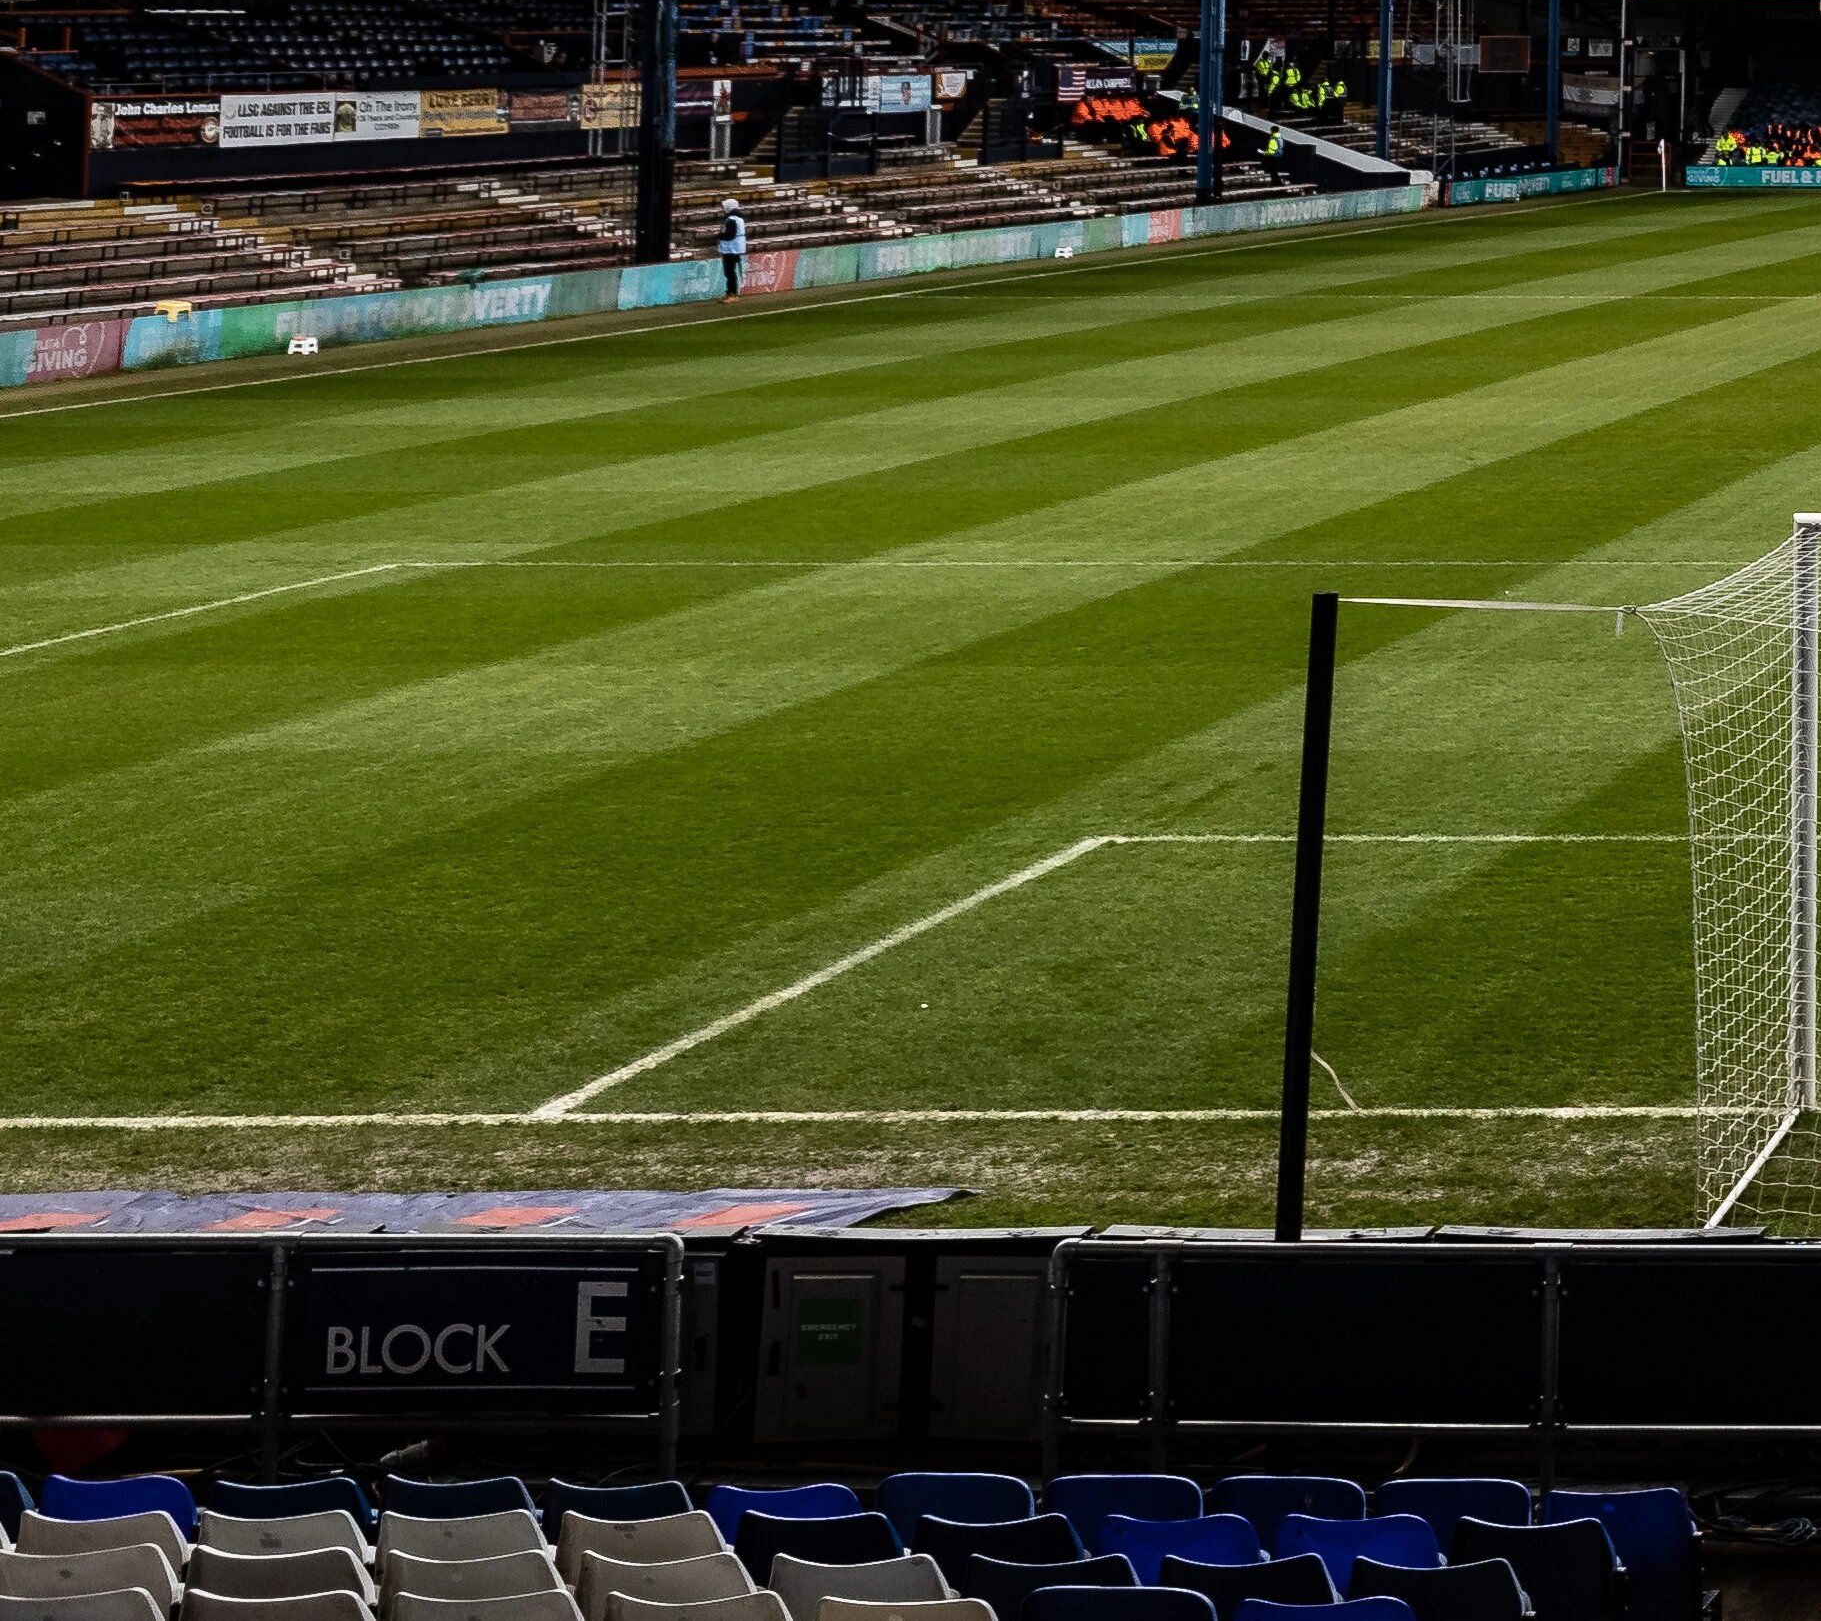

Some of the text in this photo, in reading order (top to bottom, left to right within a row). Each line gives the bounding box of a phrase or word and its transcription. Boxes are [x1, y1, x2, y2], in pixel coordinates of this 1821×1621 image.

[115, 103, 184, 117] John Charles
[260, 101, 315, 117] AGAINST THE
[375, 101, 391, 113] The
[223, 123, 309, 139] FOOTBALL IS FOR THE
[1761, 170, 1799, 184] FUEL
[23, 349, 87, 373] GIVING
[326, 1281, 628, 1374] BLOCK E
[801, 1323, 857, 1332] EMERGENCY
